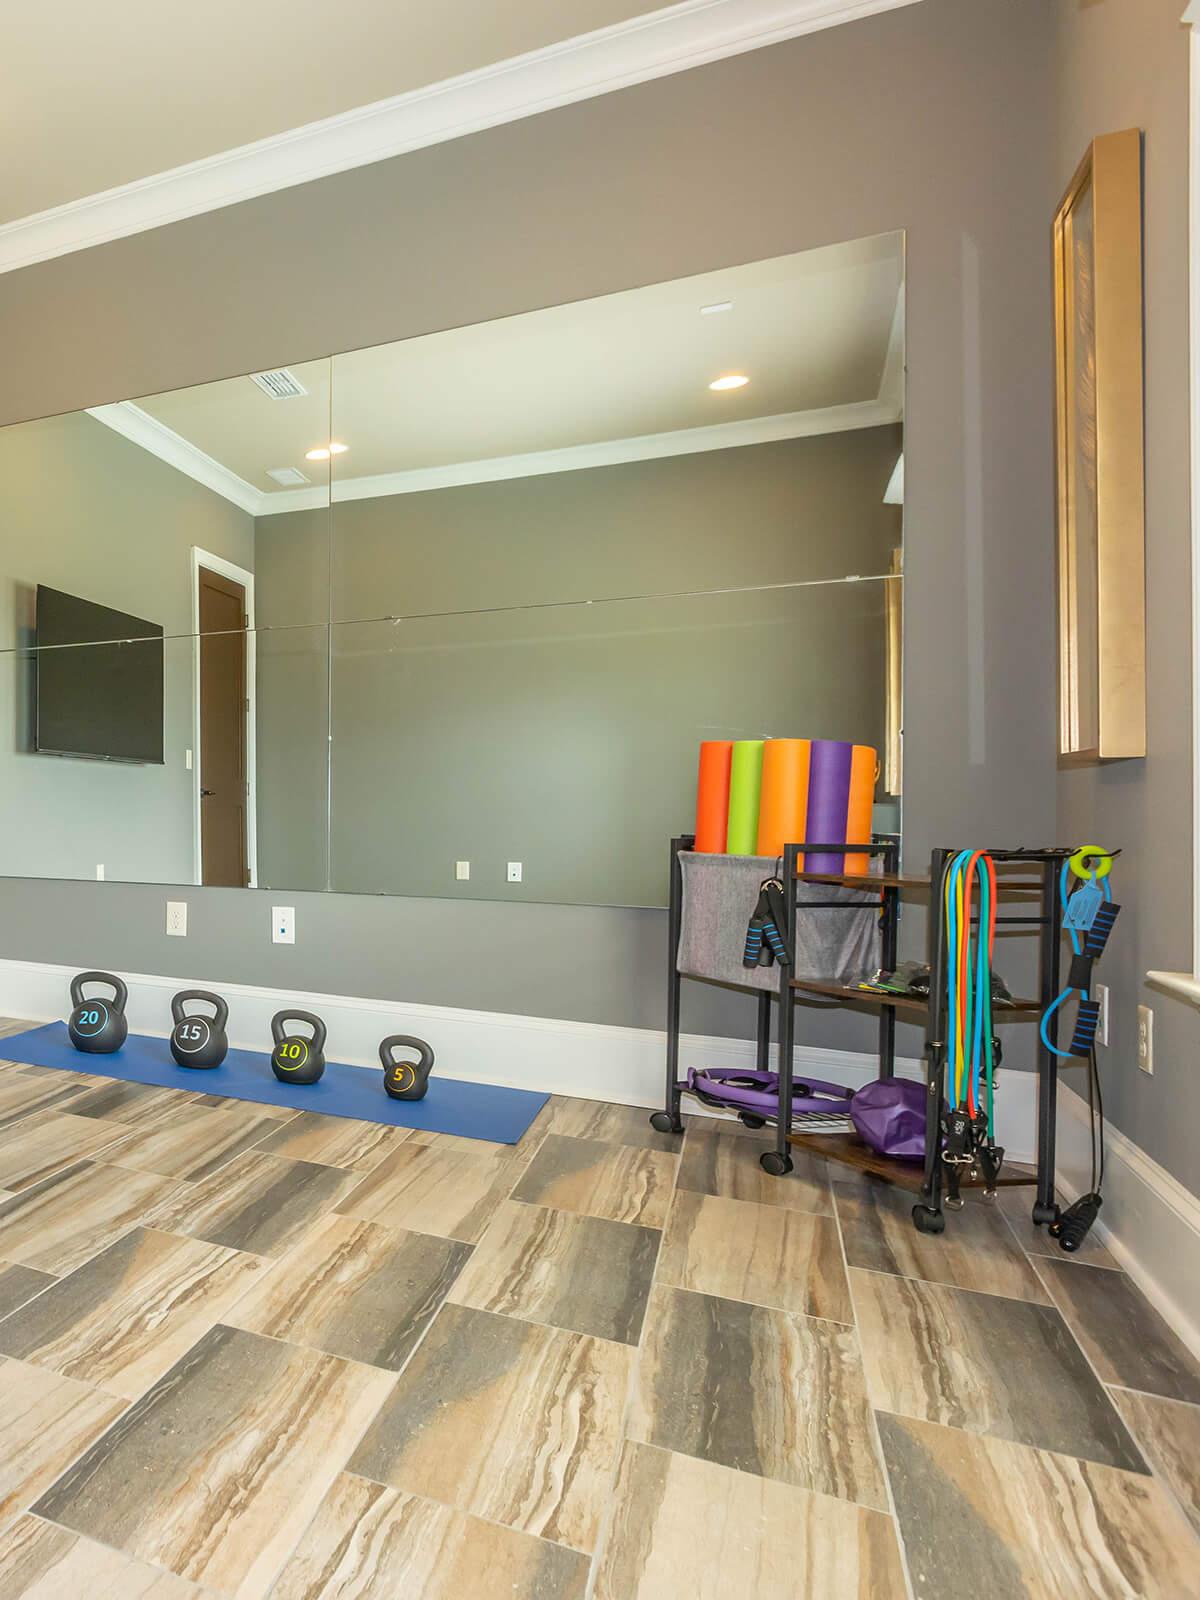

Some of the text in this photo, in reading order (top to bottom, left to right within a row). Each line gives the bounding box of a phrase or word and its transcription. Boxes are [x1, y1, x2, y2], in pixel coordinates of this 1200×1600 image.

[79, 1010, 99, 1025] 20
[180, 1024, 202, 1041] 15
[279, 1043, 301, 1059] 10
[393, 1067, 405, 1081] 5
